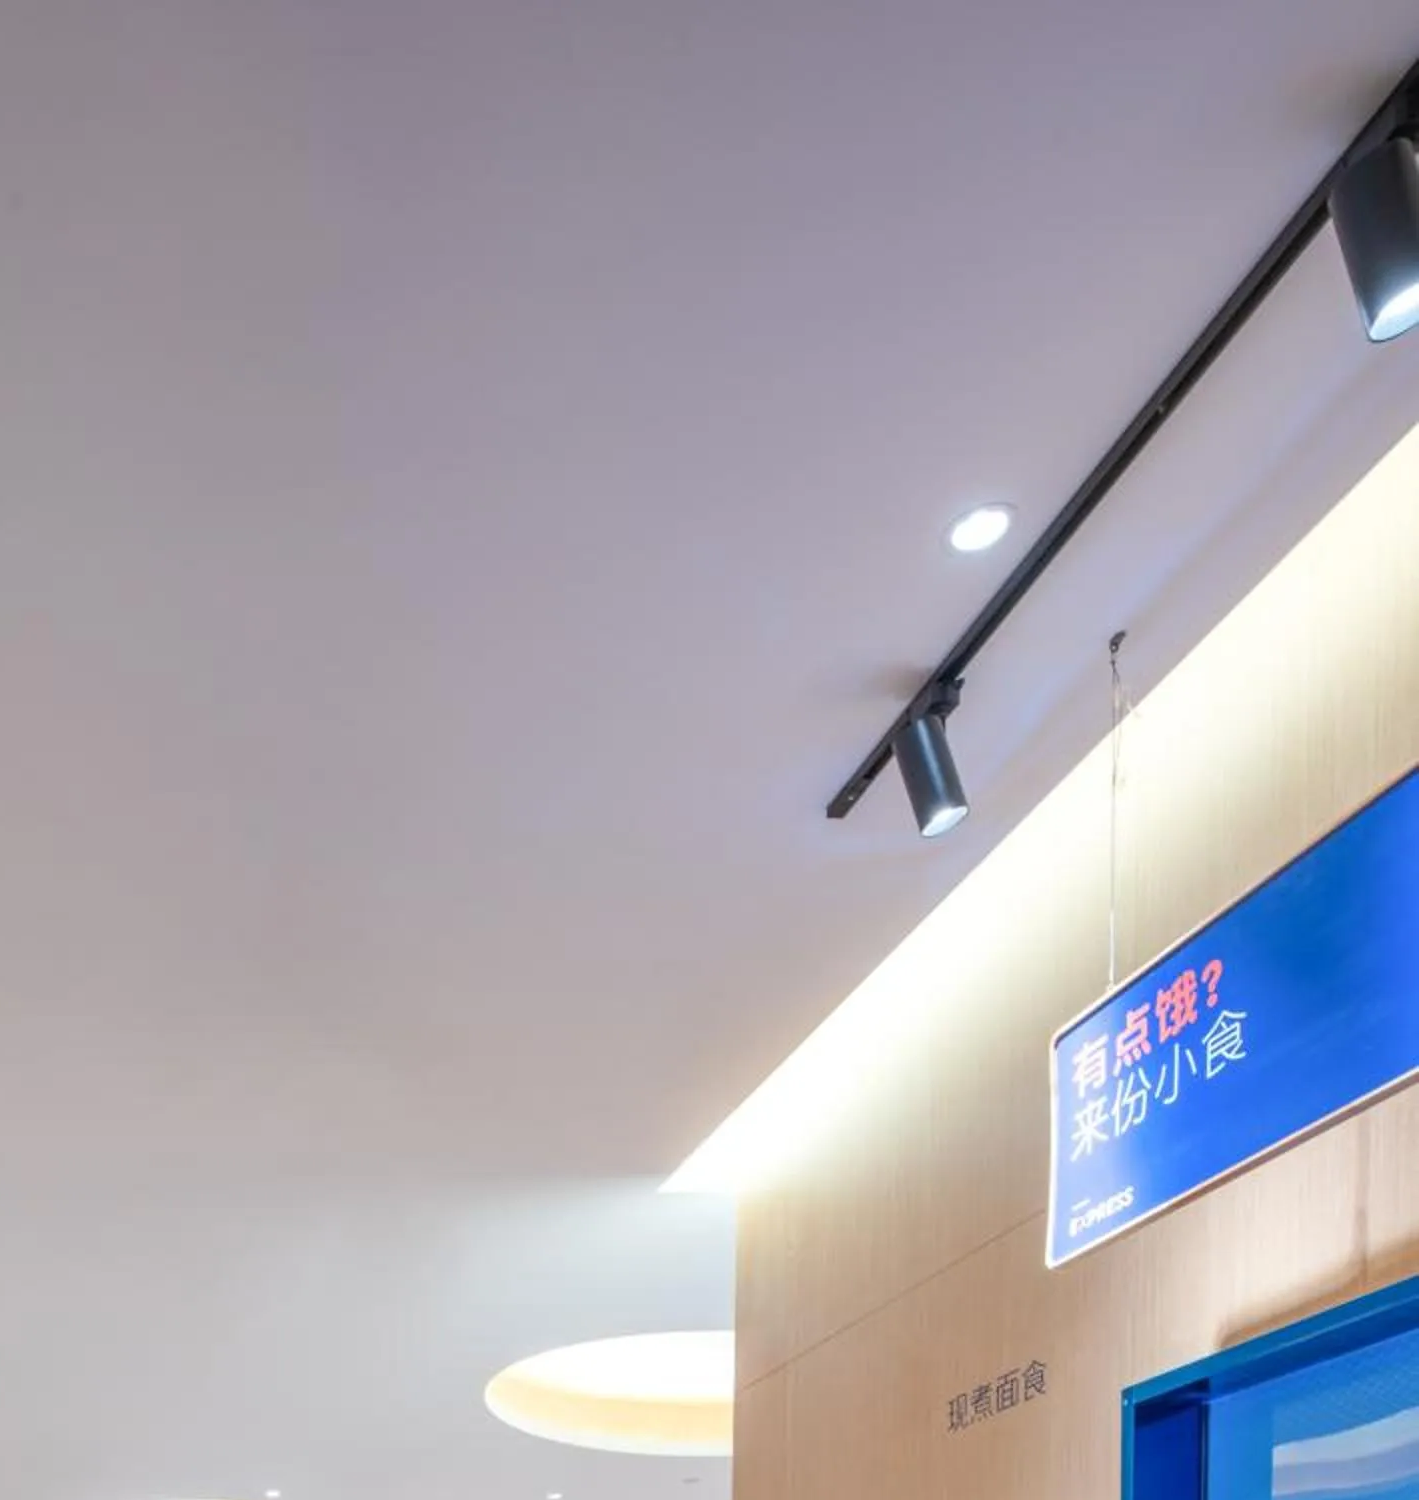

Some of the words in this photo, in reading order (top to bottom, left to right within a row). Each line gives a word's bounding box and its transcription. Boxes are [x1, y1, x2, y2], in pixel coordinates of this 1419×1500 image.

[1070, 1009, 1247, 1162] 来份小食
[947, 1359, 1047, 1433] 现煮面食
